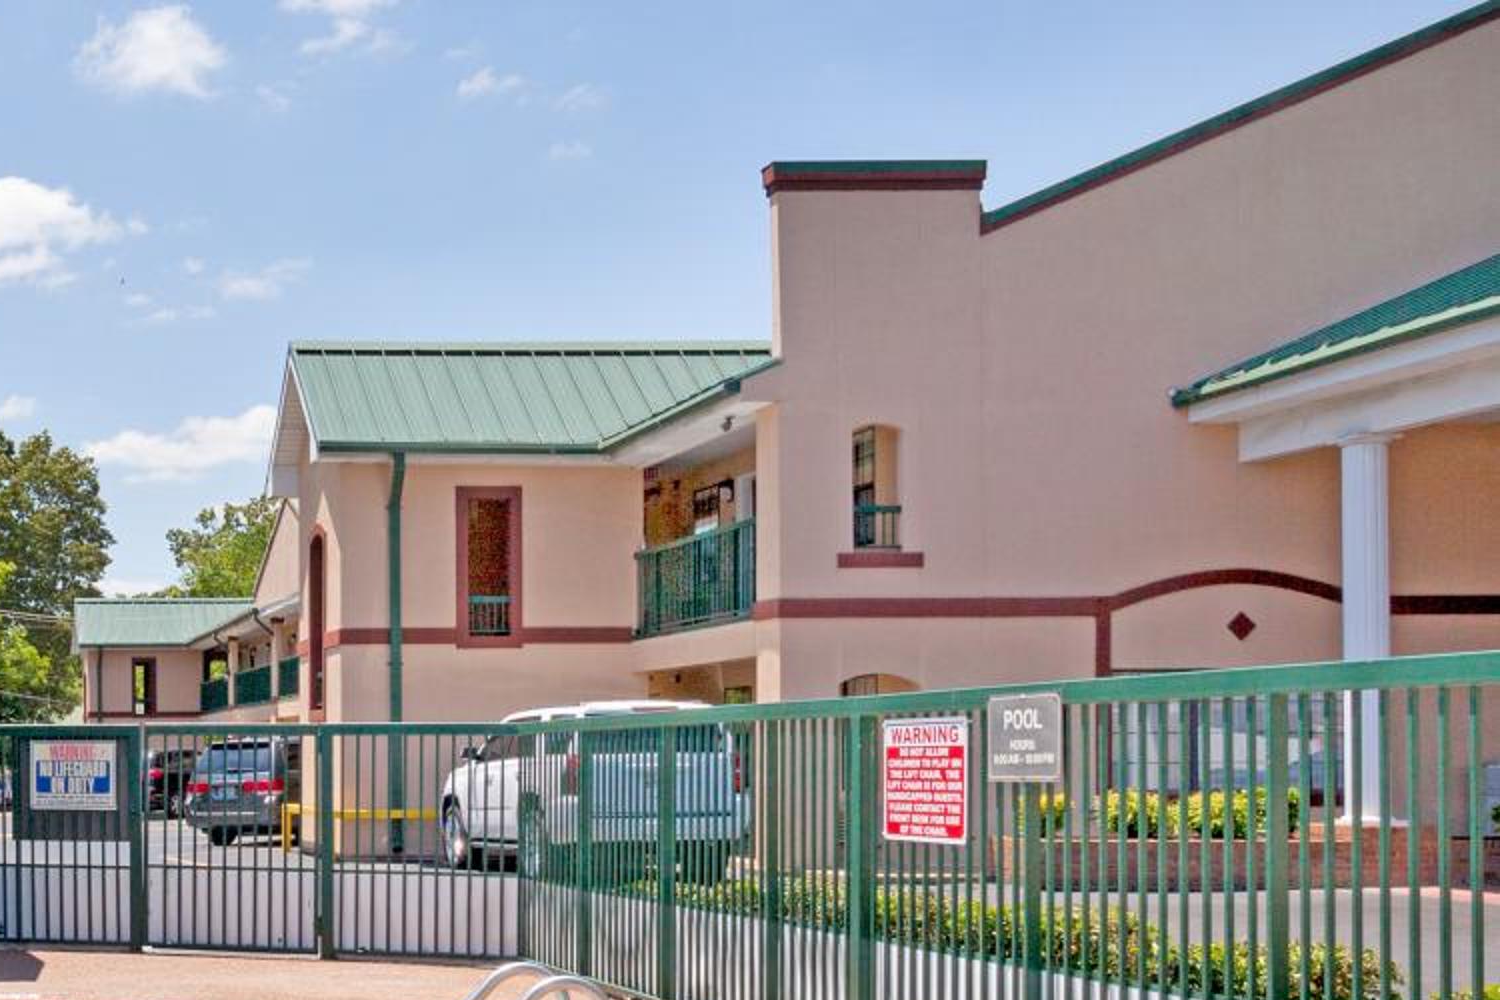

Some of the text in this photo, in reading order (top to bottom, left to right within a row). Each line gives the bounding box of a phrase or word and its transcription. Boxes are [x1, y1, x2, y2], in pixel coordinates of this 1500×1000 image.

[1003, 708, 1043, 730] POOL
[891, 725, 959, 744] WARNING
[40, 761, 106, 776] NO LIFEGUARD
[931, 758, 949, 768] PLAY
[903, 769, 918, 779] LIFT
[52, 777, 94, 793] ON DUTY
